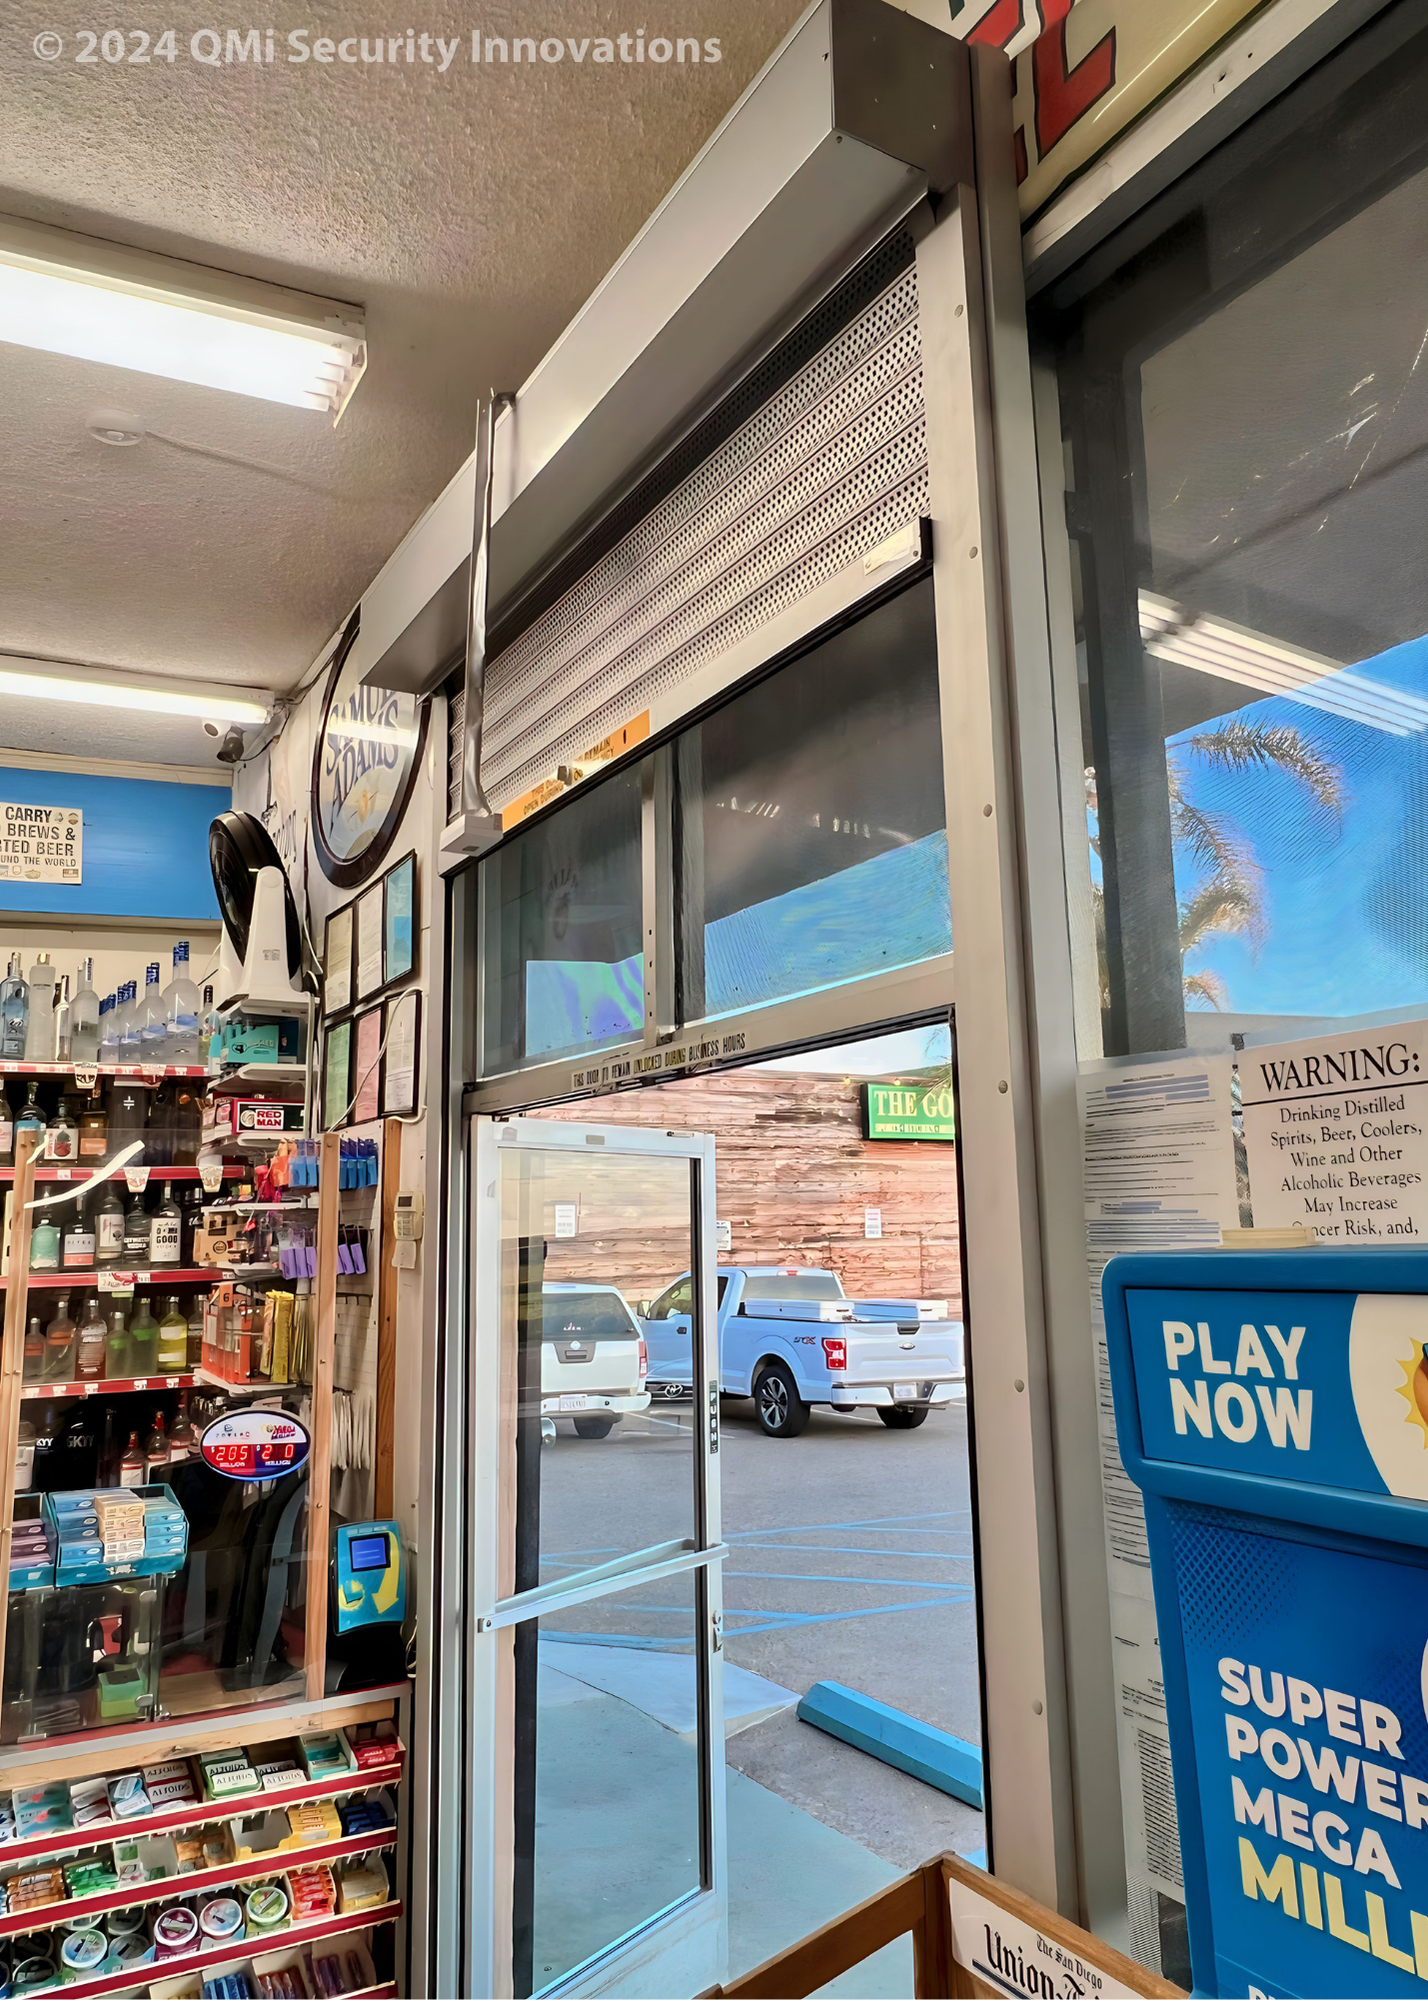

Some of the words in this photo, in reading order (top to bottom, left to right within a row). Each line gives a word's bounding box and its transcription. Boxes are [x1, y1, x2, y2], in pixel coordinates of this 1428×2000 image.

[5, 806, 52, 823] CARRY
[7, 823, 60, 840] BREWS
[65, 827, 76, 841] &
[0, 839, 30, 854] TED
[36, 841, 74, 857] BEER
[23, 856, 41, 866] THE
[44, 857, 77, 867] WORLD
[611, 1061, 631, 1078] REMAIN
[633, 1054, 663, 1074] UNLOCKED
[664, 1047, 687, 1068] DURING
[688, 1040, 720, 1062] BUSINESS
[722, 1033, 747, 1054] HOURS
[1259, 1043, 1420, 1093] WARNING:
[256, 1110, 282, 1119] RED
[873, 1090, 918, 1117] THE
[1279, 1104, 1341, 1124] Drinking
[1344, 1094, 1406, 1117] Distilled
[256, 1119, 282, 1127] MAN
[1270, 1130, 1317, 1150] Spirits,
[1320, 1126, 1357, 1143] Beer,
[1360, 1119, 1423, 1139] Coolers,
[1290, 1151, 1327, 1168] Wine
[1330, 1147, 1356, 1165] and
[1359, 1144, 1403, 1162] Other
[1280, 1172, 1345, 1192] Alcoholic
[1347, 1170, 1423, 1189] Beverages
[1303, 1197, 1335, 1217] May
[1338, 1195, 1399, 1212] Increase
[1291, 1220, 1341, 1237] ncer
[1344, 1217, 1382, 1237] Risk,
[1386, 1216, 1419, 1237] and,
[156, 1234, 178, 1244] GOOD
[222, 1292, 231, 1303] 6
[1161, 1320, 1307, 1381] PLAY
[1168, 1377, 1314, 1452] NOW
[1217, 1656, 1407, 1761] SUPER
[1224, 1712, 1428, 1830] POWER
[1230, 1774, 1403, 1891] MEGA
[1035, 1933, 1054, 1959] The
[1055, 1947, 1075, 1973] San
[1074, 1957, 1103, 1990] Diego
